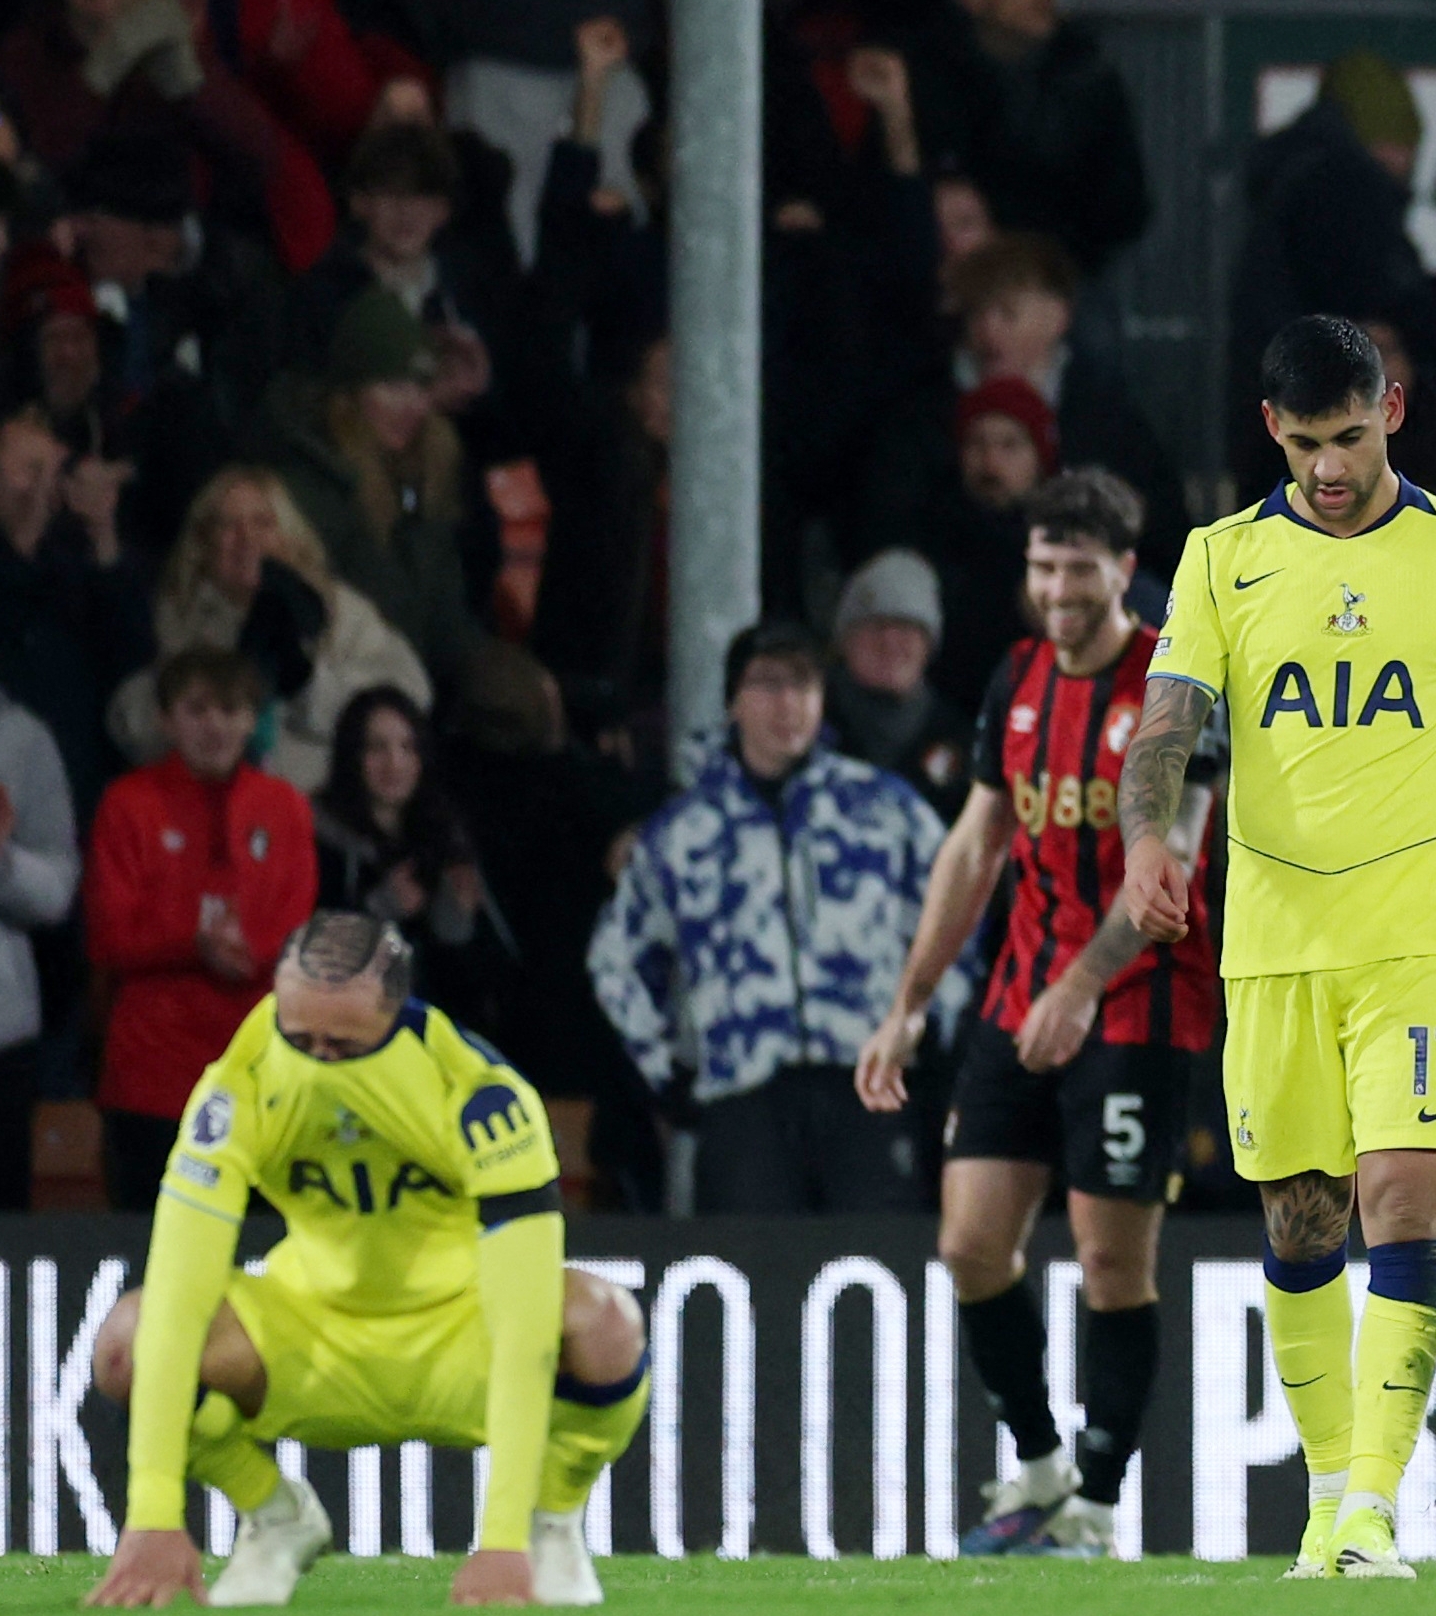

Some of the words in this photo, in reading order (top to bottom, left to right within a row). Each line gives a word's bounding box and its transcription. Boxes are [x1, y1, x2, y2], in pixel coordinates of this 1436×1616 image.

[1260, 660, 1424, 729] AIA
[1013, 771, 1118, 836] bj88
[1103, 1094, 1145, 1161] 5
[289, 1158, 455, 1213] AIA
